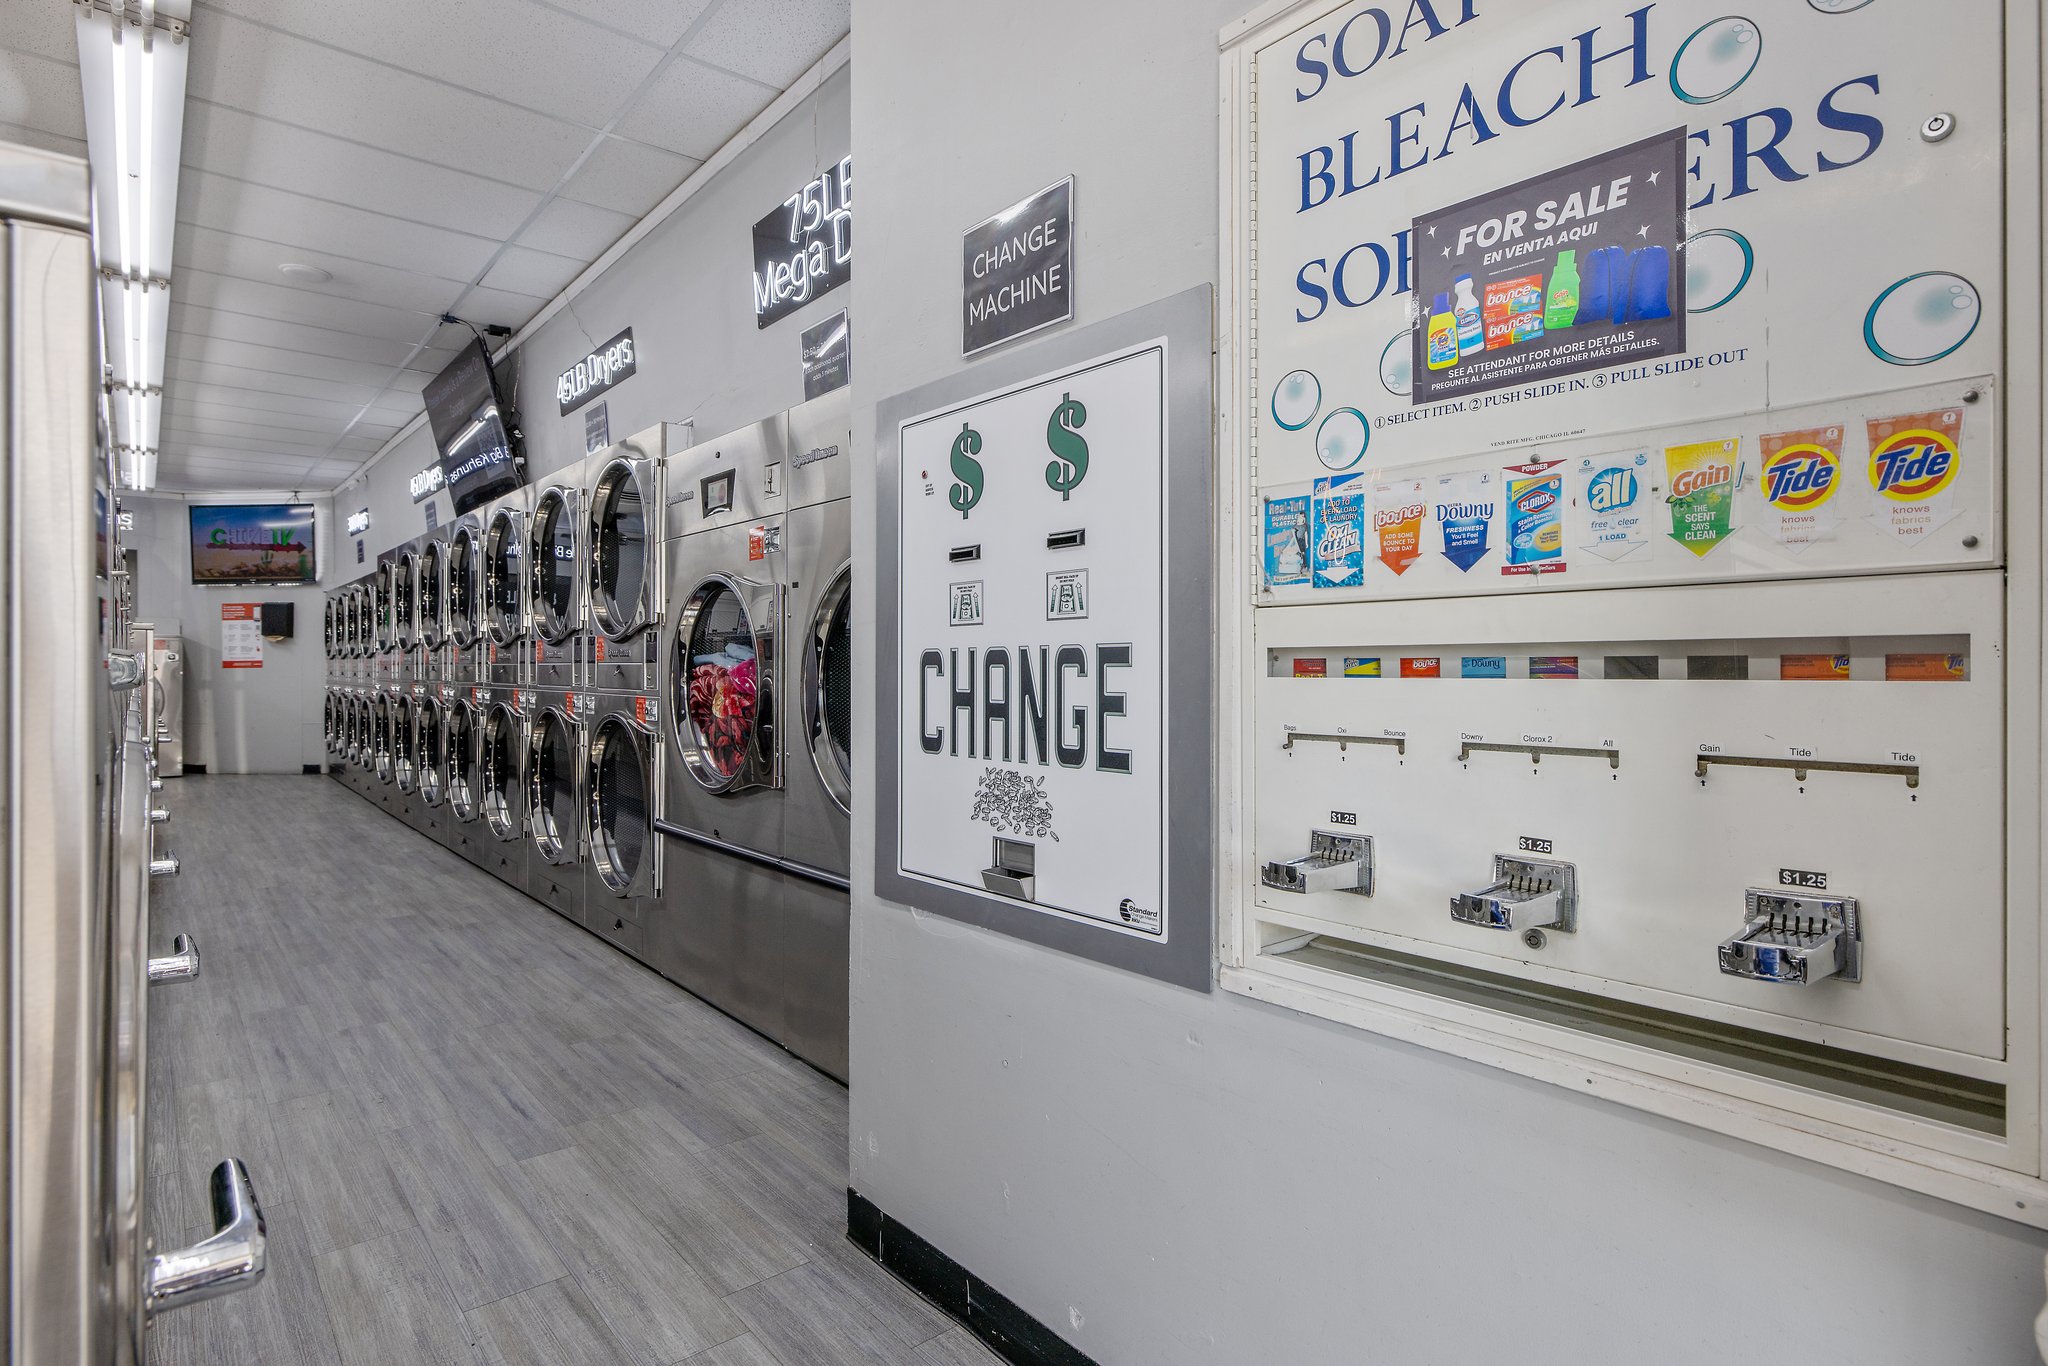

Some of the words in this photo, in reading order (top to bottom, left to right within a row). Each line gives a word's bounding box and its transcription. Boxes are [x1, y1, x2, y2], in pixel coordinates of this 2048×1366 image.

[1296, 4, 1656, 214] BLEACH
[1456, 211, 1527, 256] FOR
[1535, 176, 1631, 230] SALE
[973, 218, 1056, 278] CHANGE
[1483, 249, 1504, 266] EN
[1506, 235, 1553, 259] VENTA
[1556, 222, 1598, 244] AQUI
[753, 240, 829, 314] Mega
[970, 264, 1061, 326] MACHINE
[1487, 285, 1531, 307] bounce
[1488, 314, 1532, 338] bounce
[1448, 367, 1465, 378] SEE
[1467, 354, 1528, 375] ATTENDANT
[1530, 350, 1550, 362] FOR
[1553, 340, 1585, 356] MORE
[1588, 331, 1634, 348] DETAILS
[557, 363, 589, 403] 45LB
[587, 339, 635, 385] Dryers
[1431, 377, 1469, 391] PREGUNTE
[1470, 375, 1480, 383] AL
[1482, 367, 1523, 381] ASISTENTE
[1525, 362, 1547, 371] PARA
[1550, 353, 1588, 367] OBTENER
[1591, 347, 1611, 359] MÁS
[1613, 338, 1659, 354] DETALLES.
[1387, 409, 1430, 426] SELECT
[1433, 402, 1467, 420] ITEM.
[1484, 393, 1520, 407] PUSH
[1524, 382, 1566, 400] SLIDE
[1569, 378, 1589, 392] IN.
[1611, 367, 1651, 384] PULL
[1654, 356, 1704, 376] SLIDE
[1708, 348, 1748, 366] OUT
[1536, 432, 1562, 441] CHICAGO
[1045, 392, 1089, 501] $
[949, 422, 984, 520] $
[1522, 463, 1548, 472] POWDER
[1876, 445, 1952, 492] Tide
[1672, 465, 1730, 497] Gain
[1769, 457, 1835, 503] Tide
[1591, 469, 1633, 511] all
[1377, 504, 1423, 528] bounce
[1436, 502, 1494, 522] Downy
[1893, 505, 1930, 514] knows
[1591, 520, 1608, 529] free
[1618, 518, 1639, 526] clear
[1685, 512, 1716, 522] SCENT
[1781, 515, 1815, 524] knows
[1892, 515, 1931, 525] fabrics
[1446, 525, 1484, 533] FRESHNESS
[1685, 531, 1716, 540] CLEAN
[1898, 526, 1923, 535] best
[1413, 659, 1437, 669] bounce
[1471, 659, 1500, 669] Downy
[1833, 656, 1849, 669] Tid
[920, 642, 1132, 774] CHANGE
[1384, 729, 1406, 737] Bounce
[1461, 733, 1483, 741] Downy
[1523, 735, 1546, 743] Clorox
[1603, 739, 1613, 747] All
[1699, 744, 1720, 752] Gain
[1790, 748, 1811, 757] Tide
[1891, 752, 1916, 762] Tide
[1331, 813, 1355, 824] $1.25
[1519, 838, 1551, 852] $1.25
[1782, 871, 1826, 887] $1.25
[1129, 906, 1158, 917] Standard
